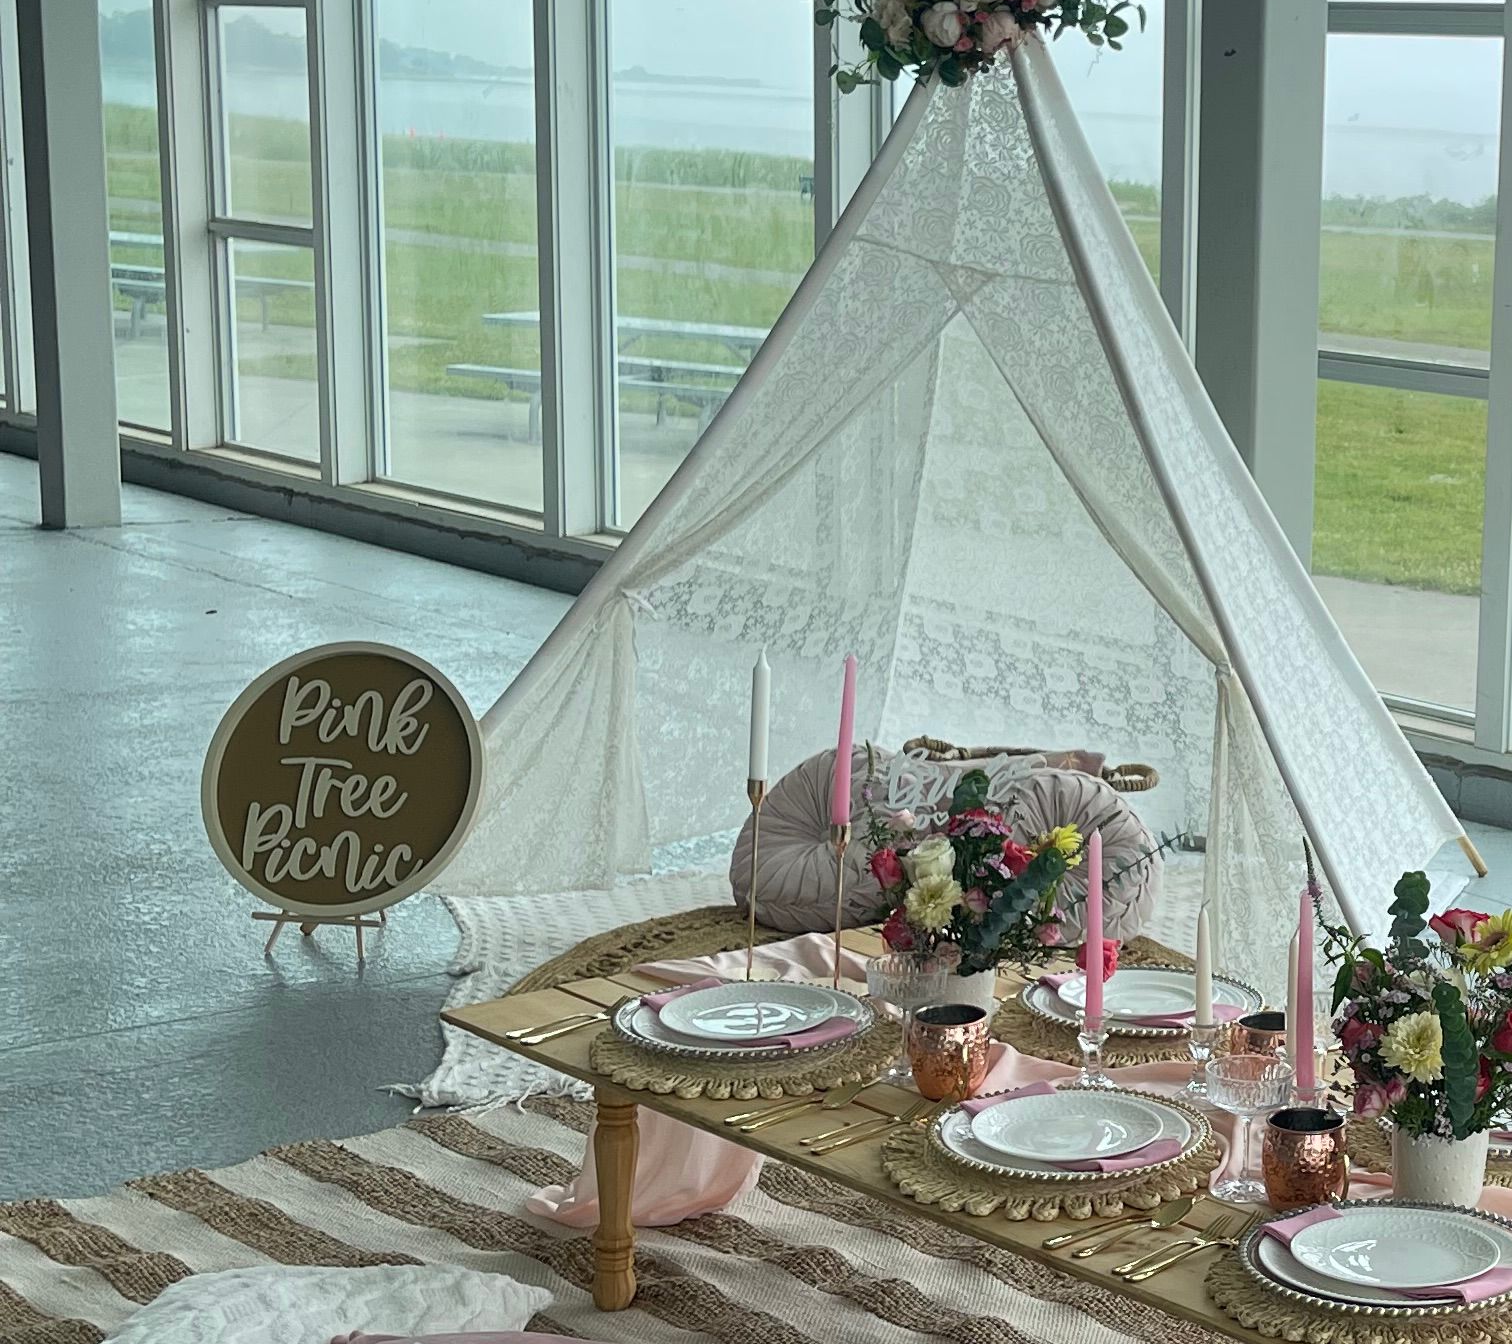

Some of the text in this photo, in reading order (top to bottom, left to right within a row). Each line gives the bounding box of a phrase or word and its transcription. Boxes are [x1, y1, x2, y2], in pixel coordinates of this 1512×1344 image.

[280, 675, 433, 755] Pink
[280, 756, 408, 829] Tree
[242, 801, 424, 893] Picnic
